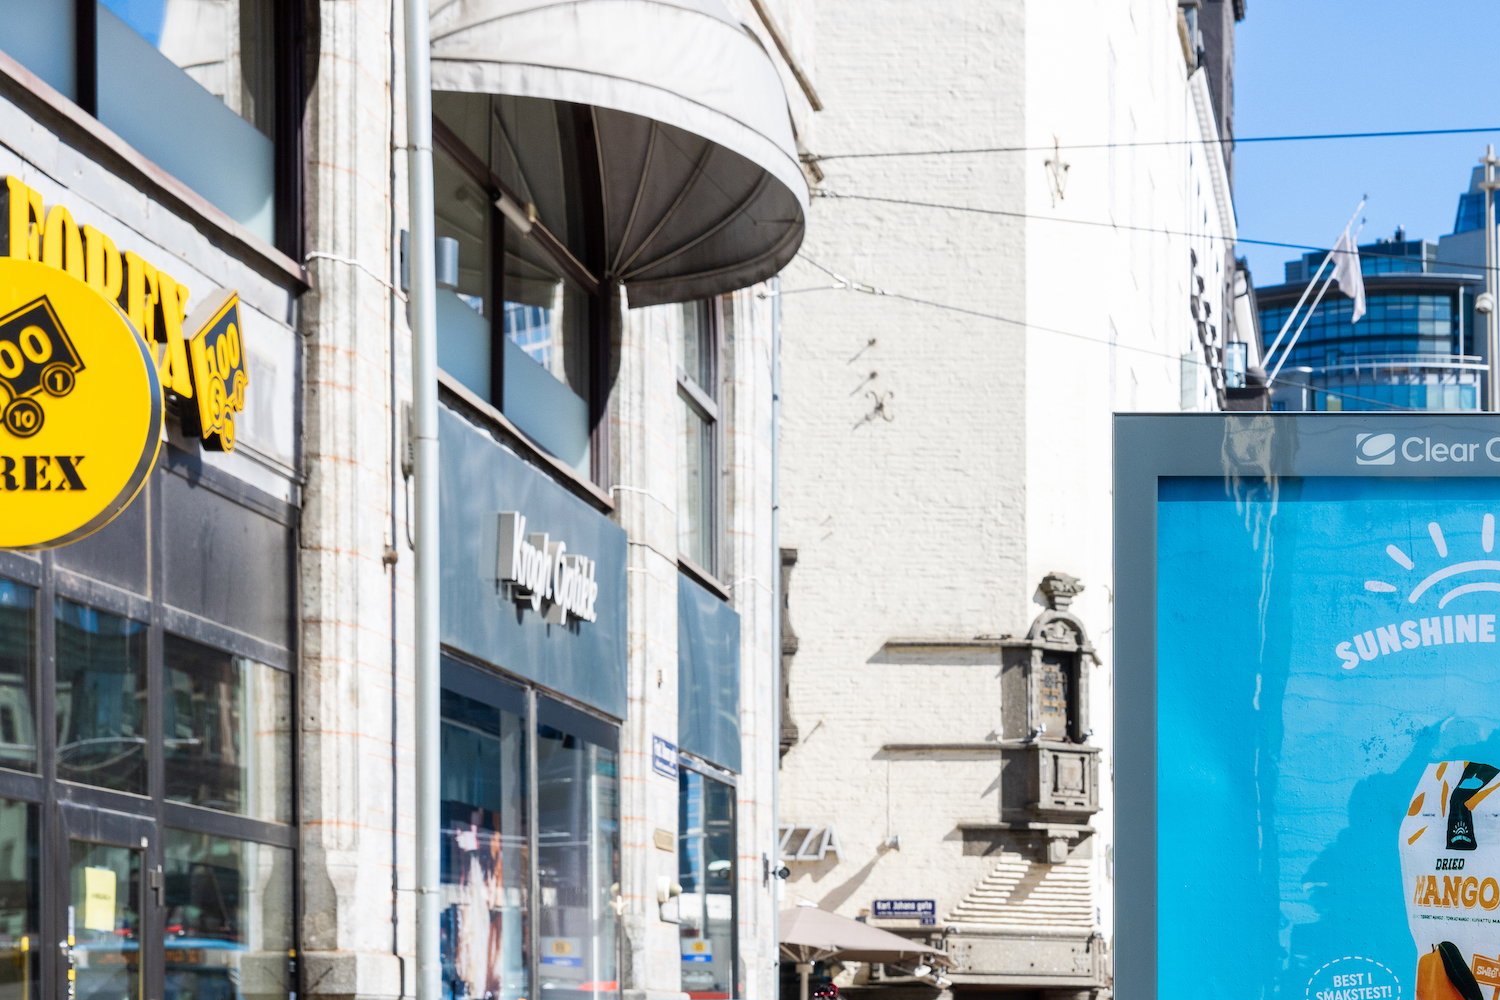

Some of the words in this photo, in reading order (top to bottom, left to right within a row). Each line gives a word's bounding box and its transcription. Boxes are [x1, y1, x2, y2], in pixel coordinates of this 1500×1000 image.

[13, 411, 36, 429] 10
[1402, 437, 1479, 462] Clear
[0, 455, 87, 491] REX
[512, 510, 553, 613] Krogh
[1335, 614, 1496, 670] SUNSHINE
[779, 824, 844, 861] ZZA
[1435, 858, 1465, 871] DRIED
[1333, 973, 1364, 988] BEST
[1367, 972, 1372, 985] I
